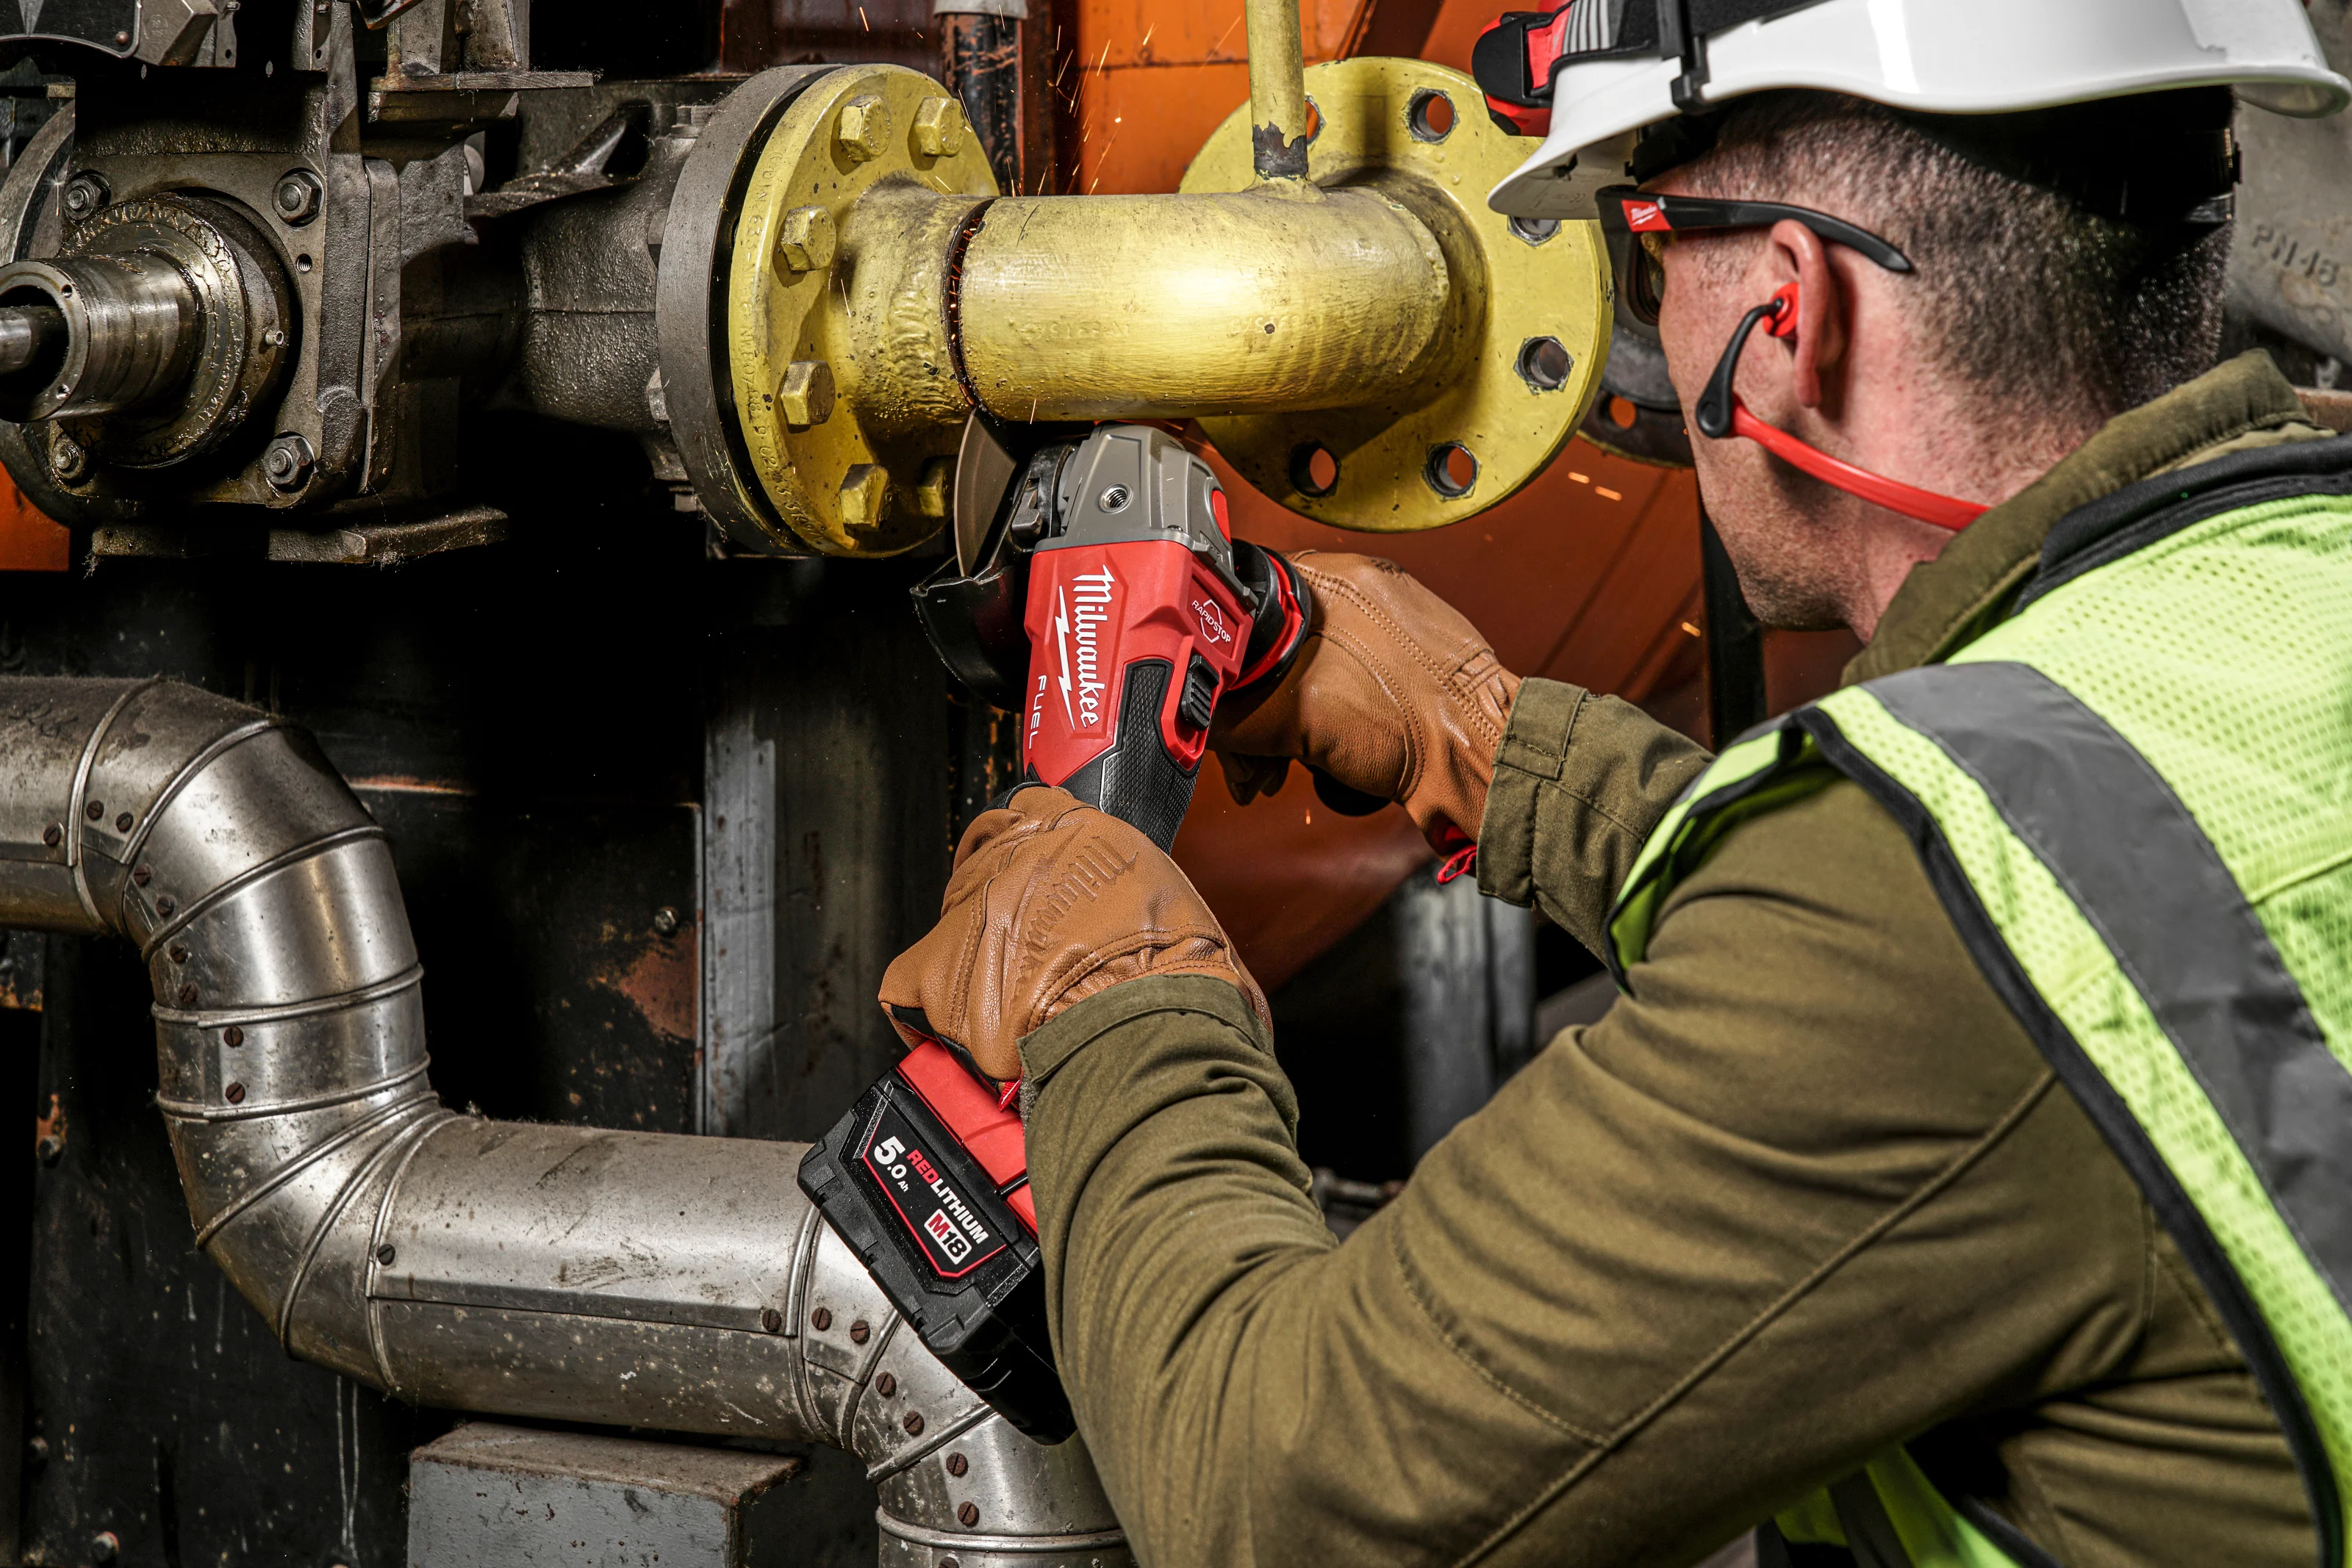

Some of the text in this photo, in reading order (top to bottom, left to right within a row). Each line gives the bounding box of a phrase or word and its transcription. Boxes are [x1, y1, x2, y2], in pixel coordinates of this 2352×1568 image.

[1072, 564, 1117, 729] Milwaukee
[1028, 675, 1047, 750] FUEL
[897, 1179, 910, 1193] Ah
[906, 1148, 989, 1245] REDLITHIUM
[928, 1212, 969, 1261] M18
